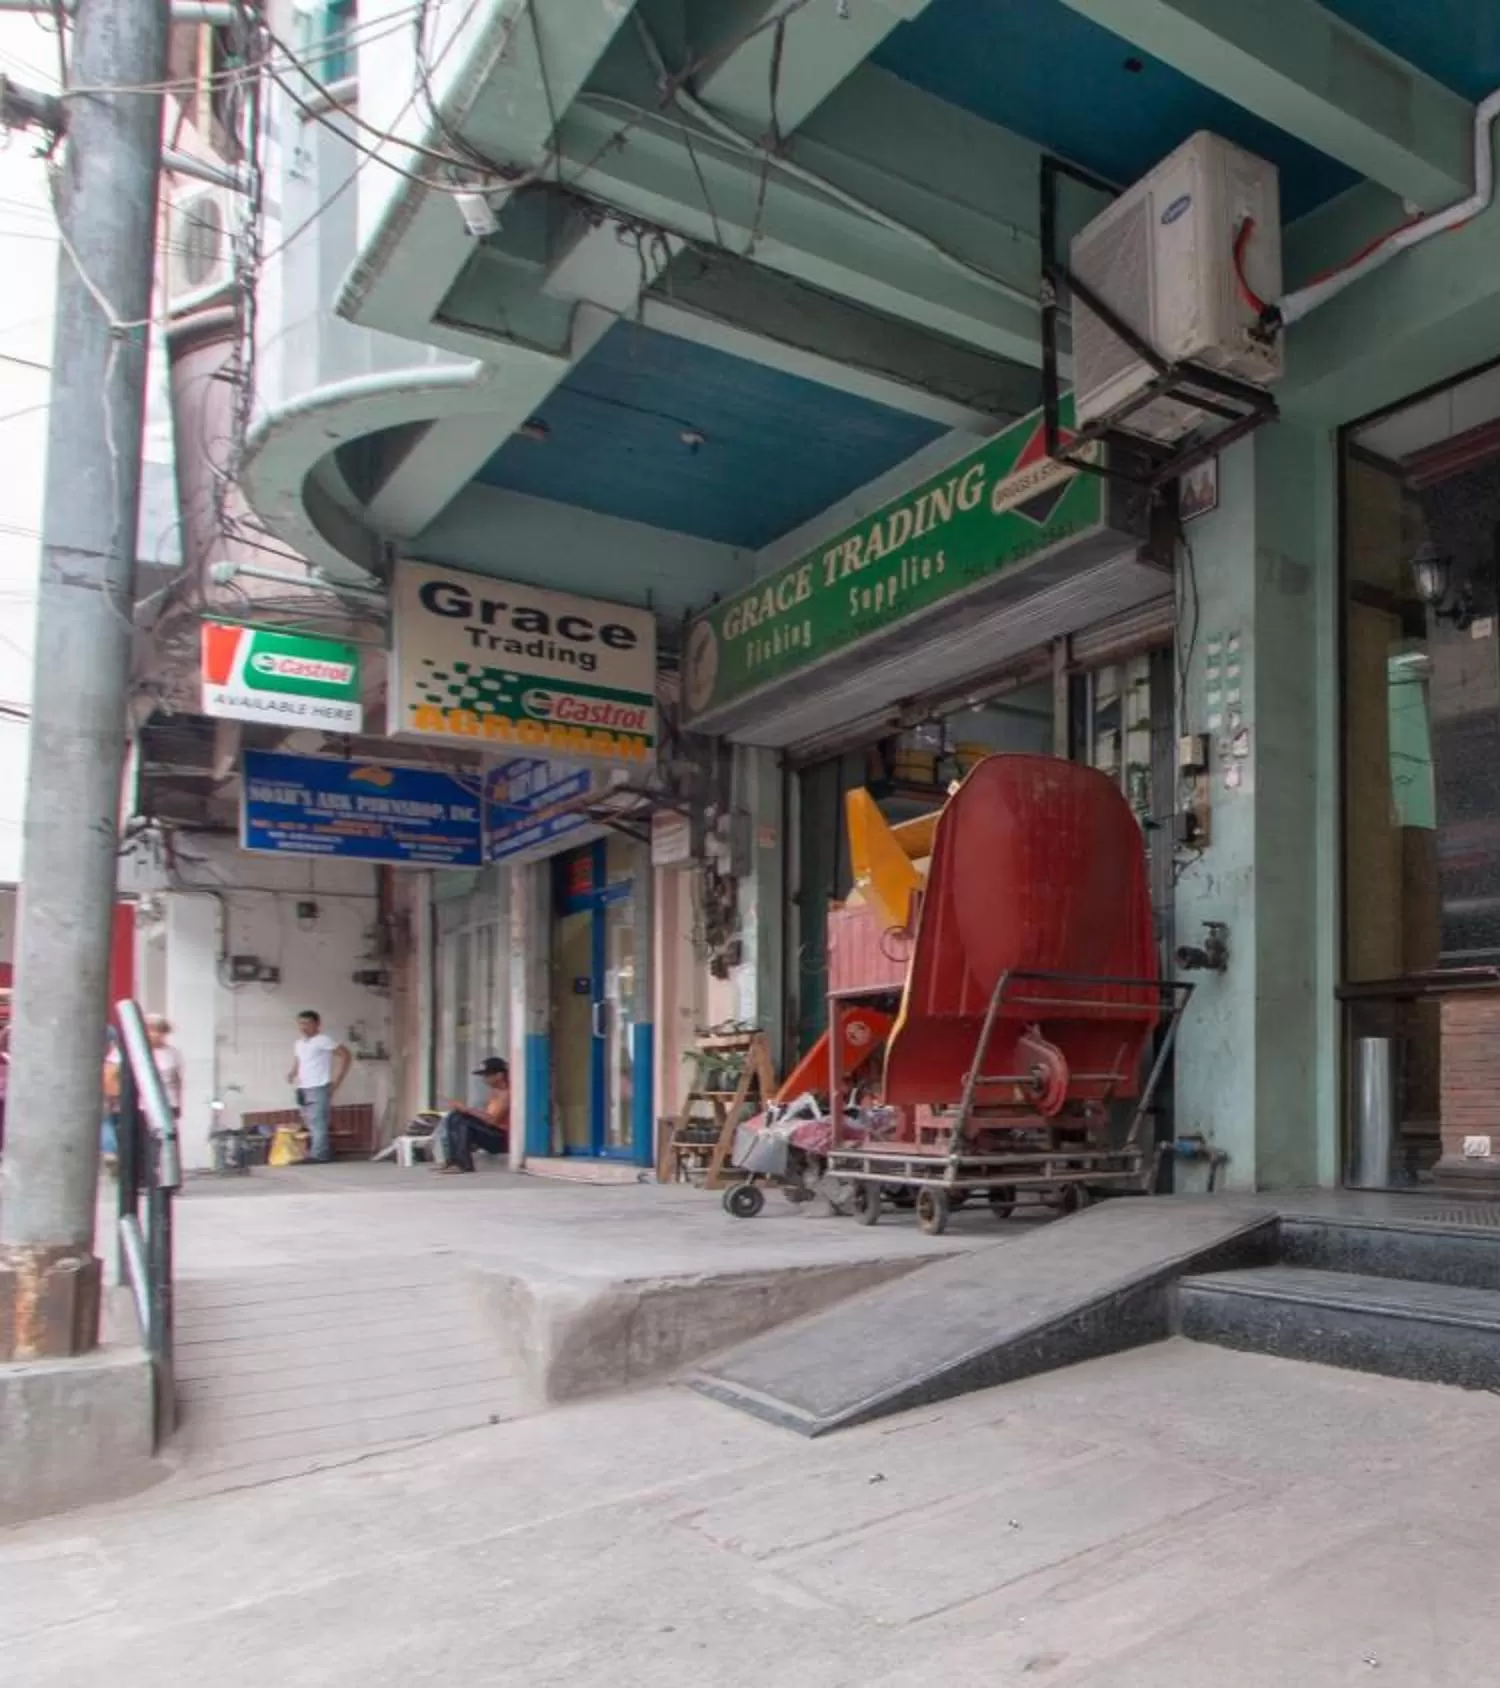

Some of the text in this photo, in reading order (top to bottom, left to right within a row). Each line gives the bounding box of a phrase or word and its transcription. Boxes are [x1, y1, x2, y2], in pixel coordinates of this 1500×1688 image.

[722, 563, 813, 641] GRACE
[823, 463, 986, 587] TRADING
[419, 581, 637, 650] Grace
[746, 620, 812, 668] Fishing
[850, 551, 945, 617] Supplies
[277, 659, 350, 682] Castrol
[464, 625, 597, 672] Trading
[213, 693, 353, 721] AVAILABLE HERE
[552, 697, 648, 730] Castrol
